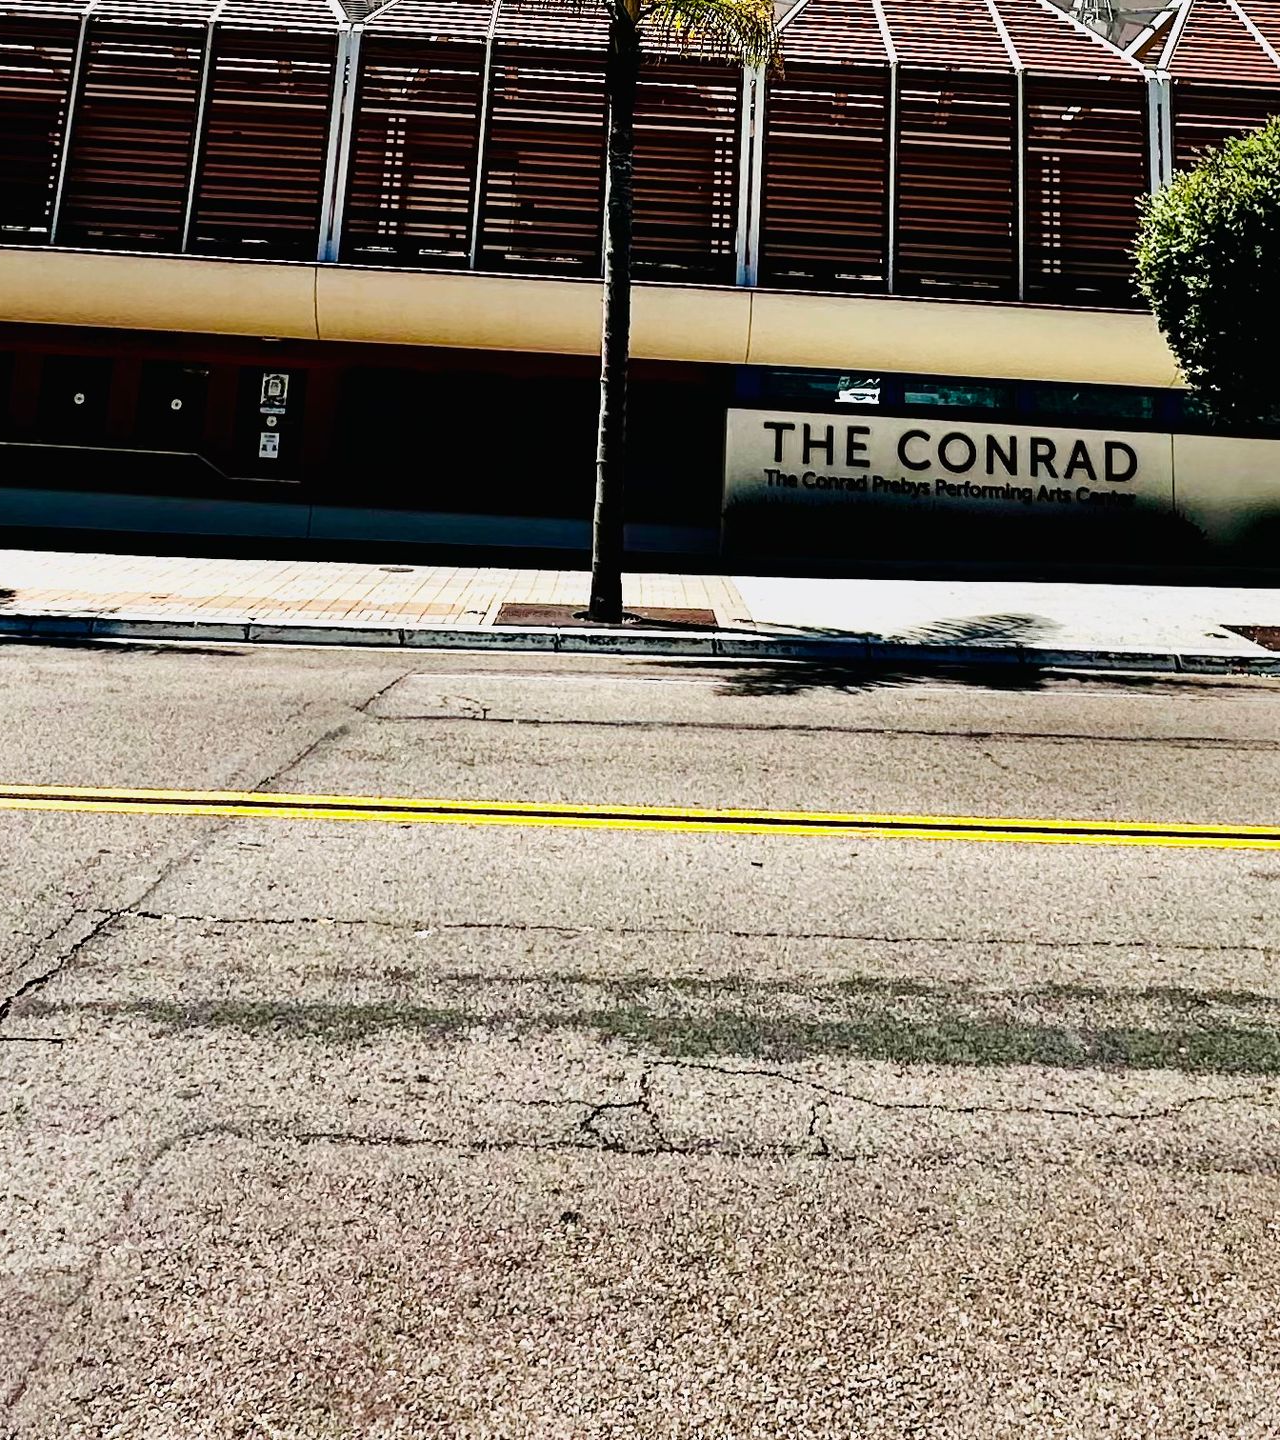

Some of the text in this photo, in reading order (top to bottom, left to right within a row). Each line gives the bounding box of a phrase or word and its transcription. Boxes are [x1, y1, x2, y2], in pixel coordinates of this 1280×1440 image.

[764, 422, 1138, 483] THE CONRAD
[764, 469, 798, 488] The
[802, 471, 868, 491] Conrad
[872, 475, 931, 498] Prebys
[935, 478, 1033, 505] Performing
[1037, 485, 1071, 503] Arts
